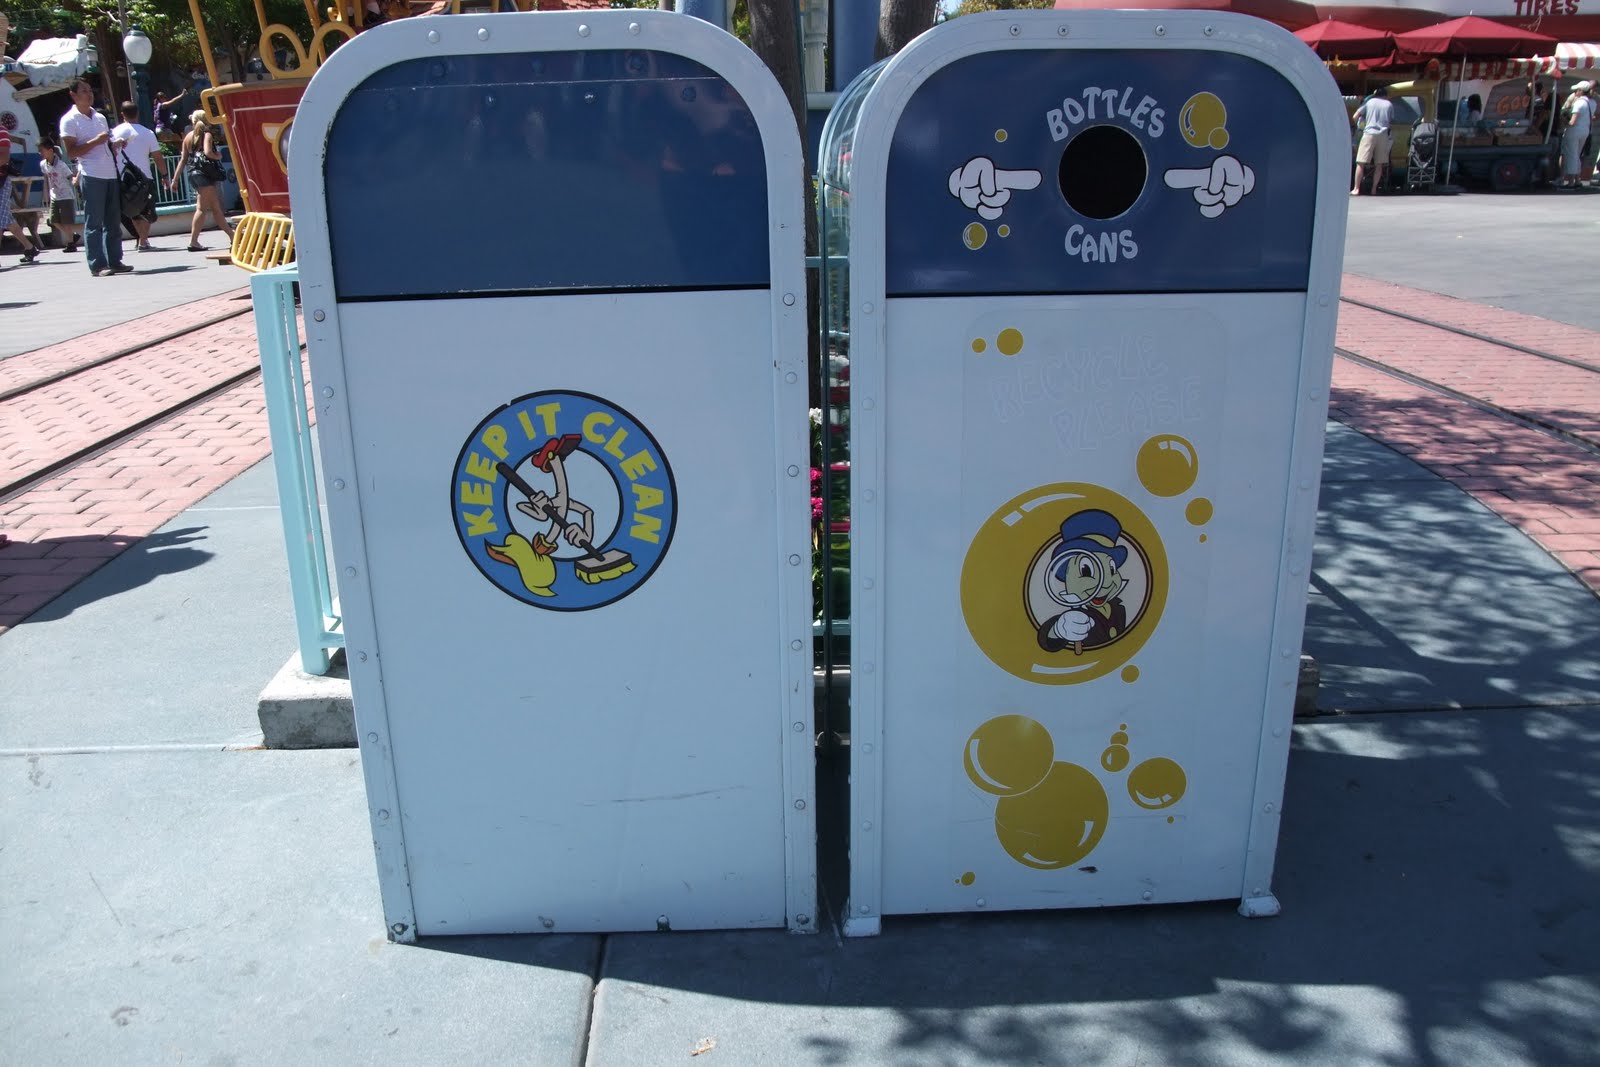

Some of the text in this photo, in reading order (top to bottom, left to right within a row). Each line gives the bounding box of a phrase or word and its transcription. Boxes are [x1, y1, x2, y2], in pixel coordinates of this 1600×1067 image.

[1514, 0, 1580, 16] TIRES
[1046, 86, 1166, 142] BOTTLES
[1064, 223, 1138, 263] CANS
[460, 402, 664, 545] KEEP IT CLEAN
